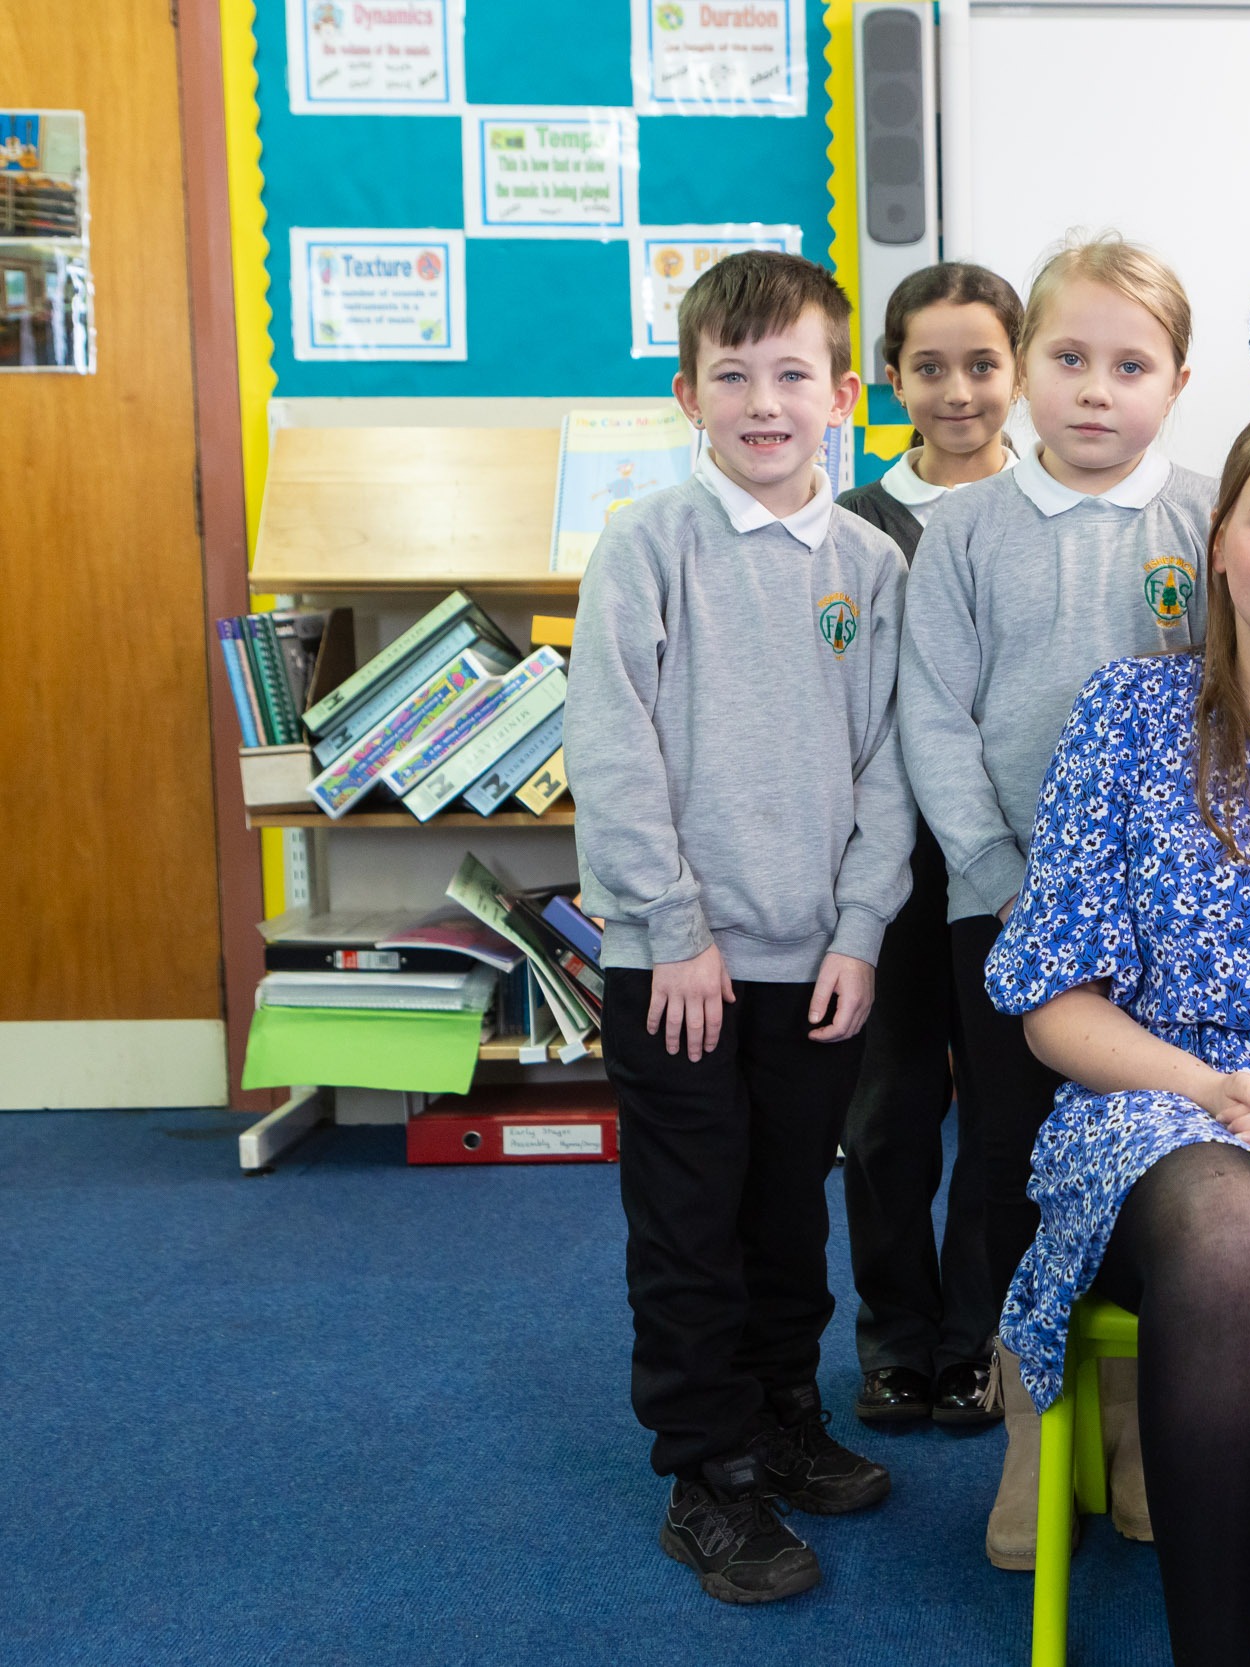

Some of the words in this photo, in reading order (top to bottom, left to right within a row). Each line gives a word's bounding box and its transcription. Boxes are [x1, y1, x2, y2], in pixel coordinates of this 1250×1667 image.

[353, 3, 433, 31] Dynamics
[700, 4, 778, 28] Duration
[341, 254, 412, 278] Texture
[1150, 580, 1163, 604] F
[825, 615, 837, 639] F
[843, 619, 854, 643] S
[509, 1127, 535, 1138] Early
[511, 1139, 550, 1149] Assembly
